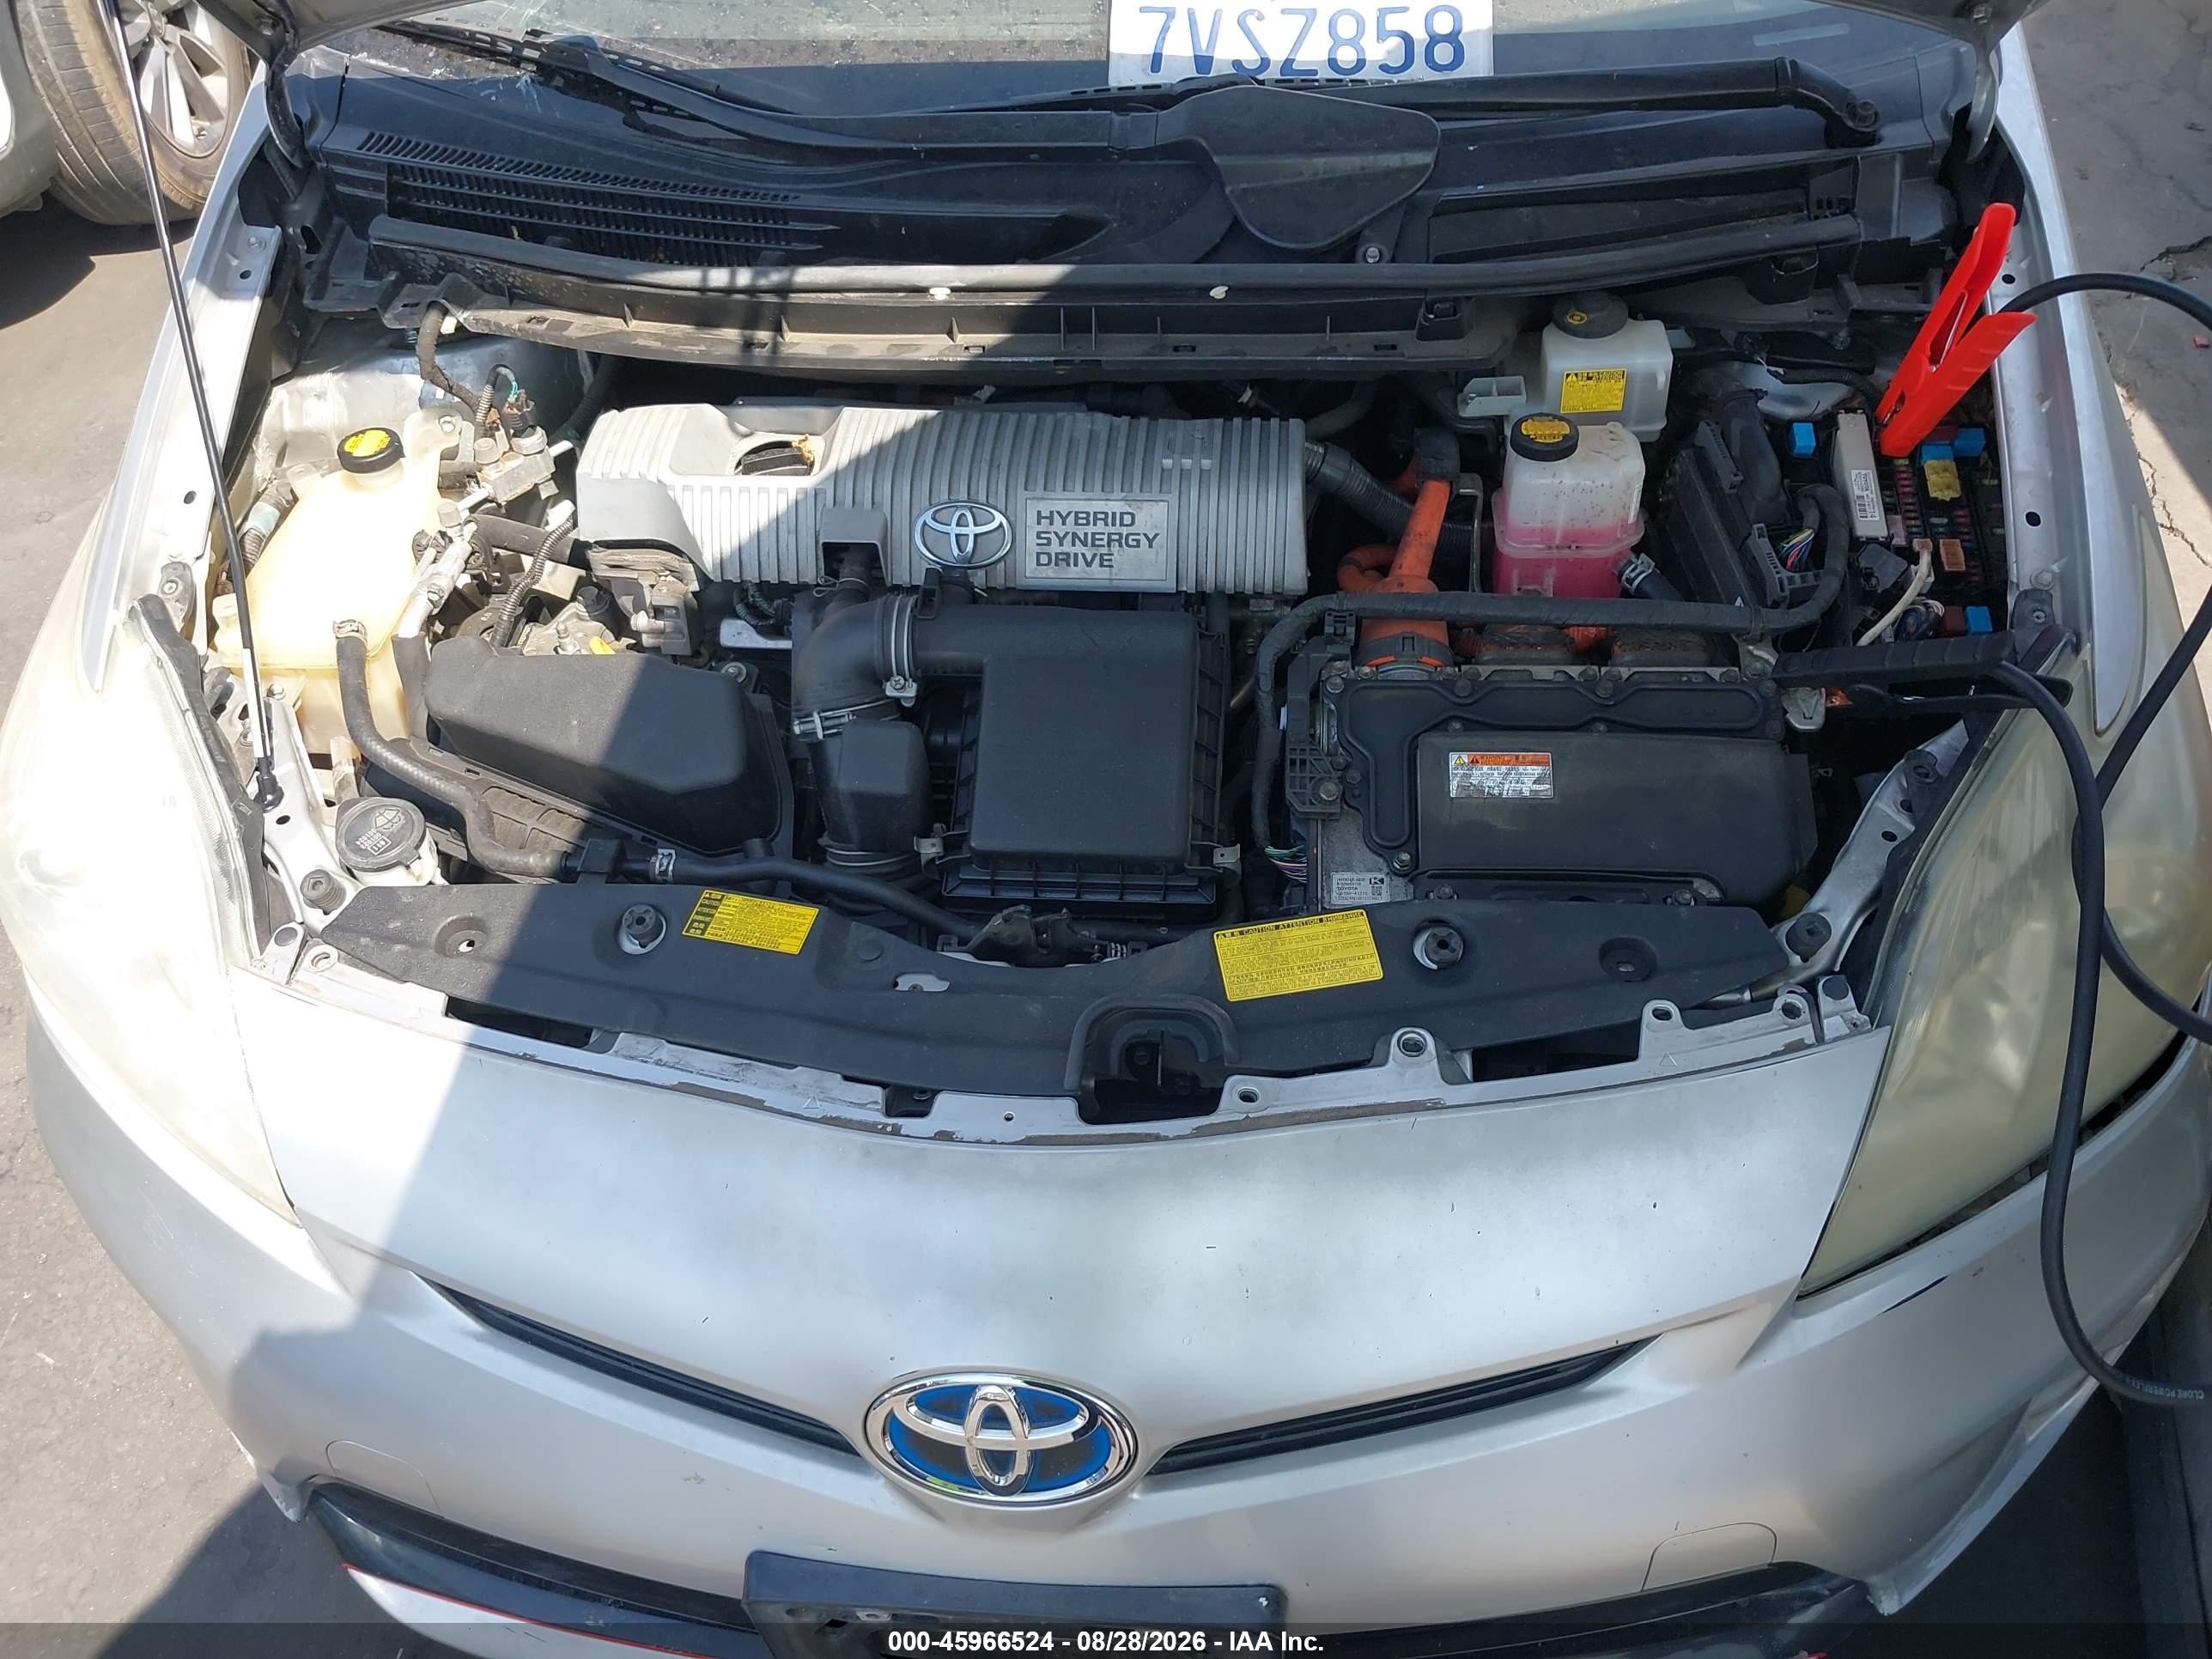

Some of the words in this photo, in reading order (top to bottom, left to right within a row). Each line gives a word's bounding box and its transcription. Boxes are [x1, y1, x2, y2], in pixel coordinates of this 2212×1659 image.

[1139, 4, 1467, 77] 7VSZ858
[1036, 510, 1136, 527] HYBRID
[1036, 531, 1160, 549] SYNERGY
[1036, 551, 1115, 568] DRIVE
[1243, 925, 1276, 936] CAUTION
[1279, 918, 1319, 931] ATTENTION
[2177, 1389, 2205, 1400] CLORE
